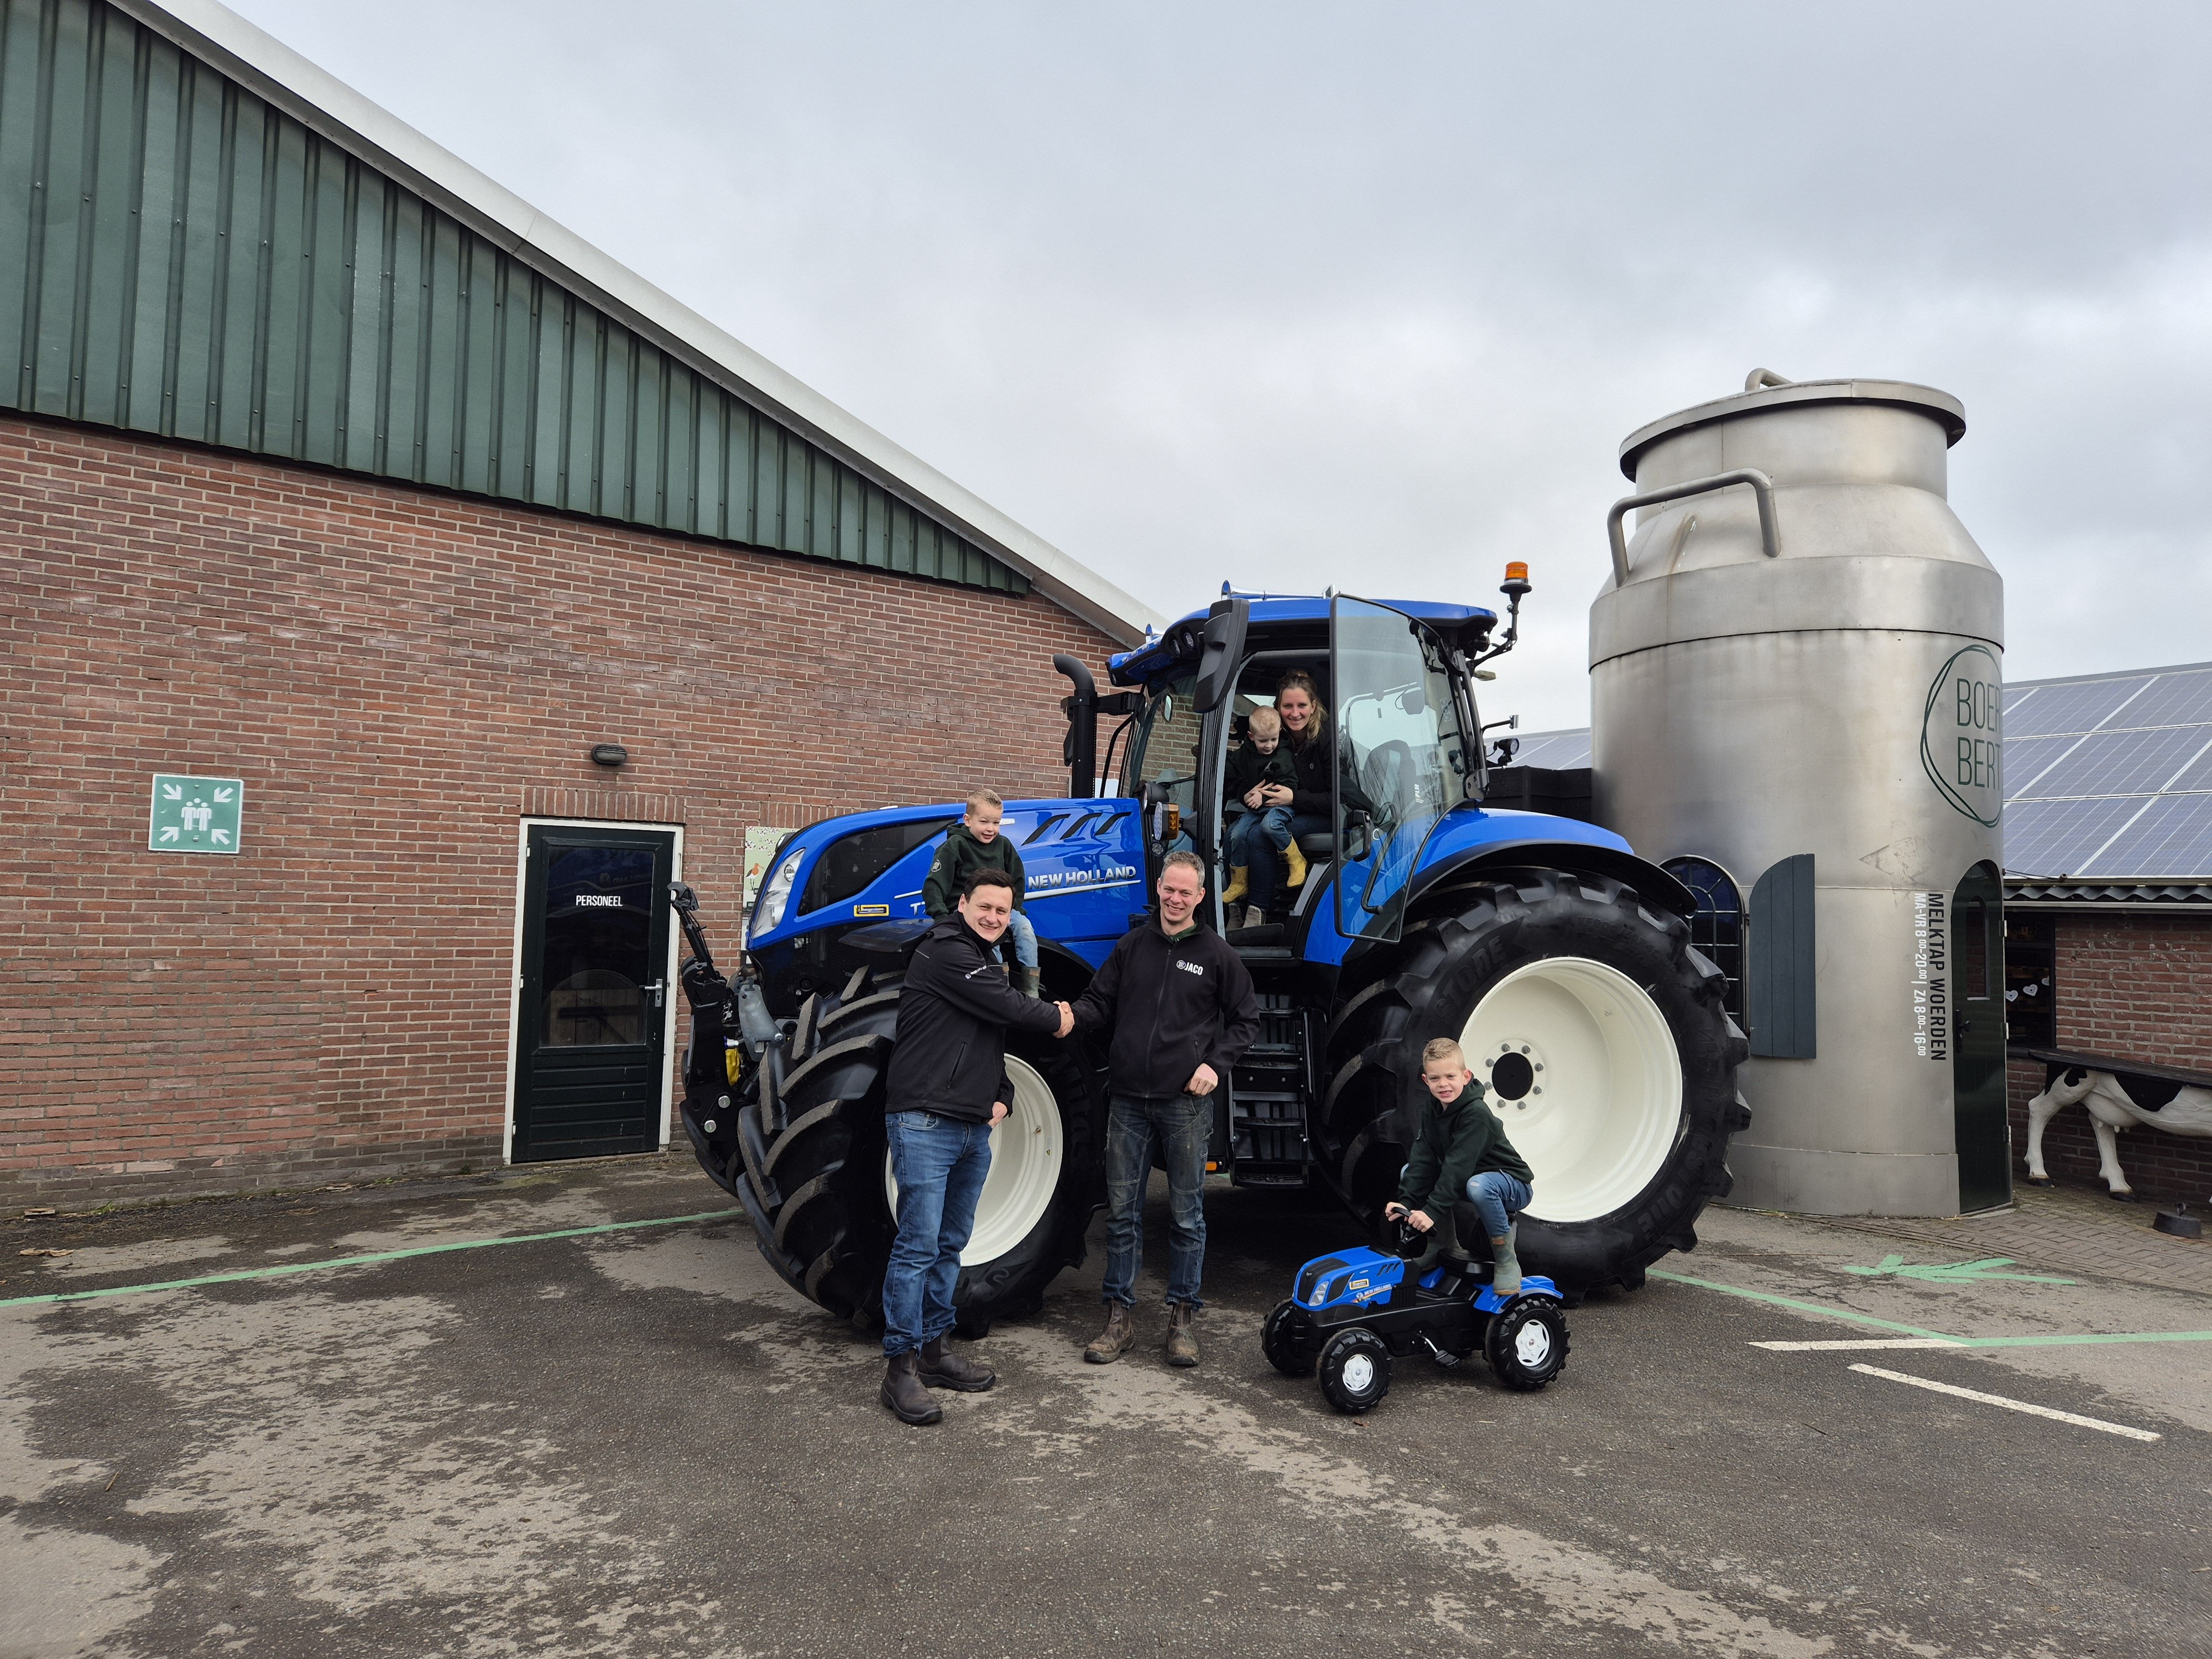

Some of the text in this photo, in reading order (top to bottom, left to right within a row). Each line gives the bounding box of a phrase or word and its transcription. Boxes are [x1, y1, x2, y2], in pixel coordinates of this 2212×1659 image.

[1957, 678, 2001, 735] BOER
[1958, 737, 2001, 791] BERT
[1028, 866, 1136, 889] NEW HOLLAND
[576, 895, 623, 906] PERSONEEL
[1914, 893, 1927, 927] MA-VR
[1184, 962, 1204, 975] JACO
[1928, 893, 1947, 1061] MELKTAP WOERDEN
[1914, 989, 1926, 1004] ZA
[1637, 1027, 1720, 1243] BRIDGESTONE
[1374, 1284, 1391, 1292] HOLLAND
